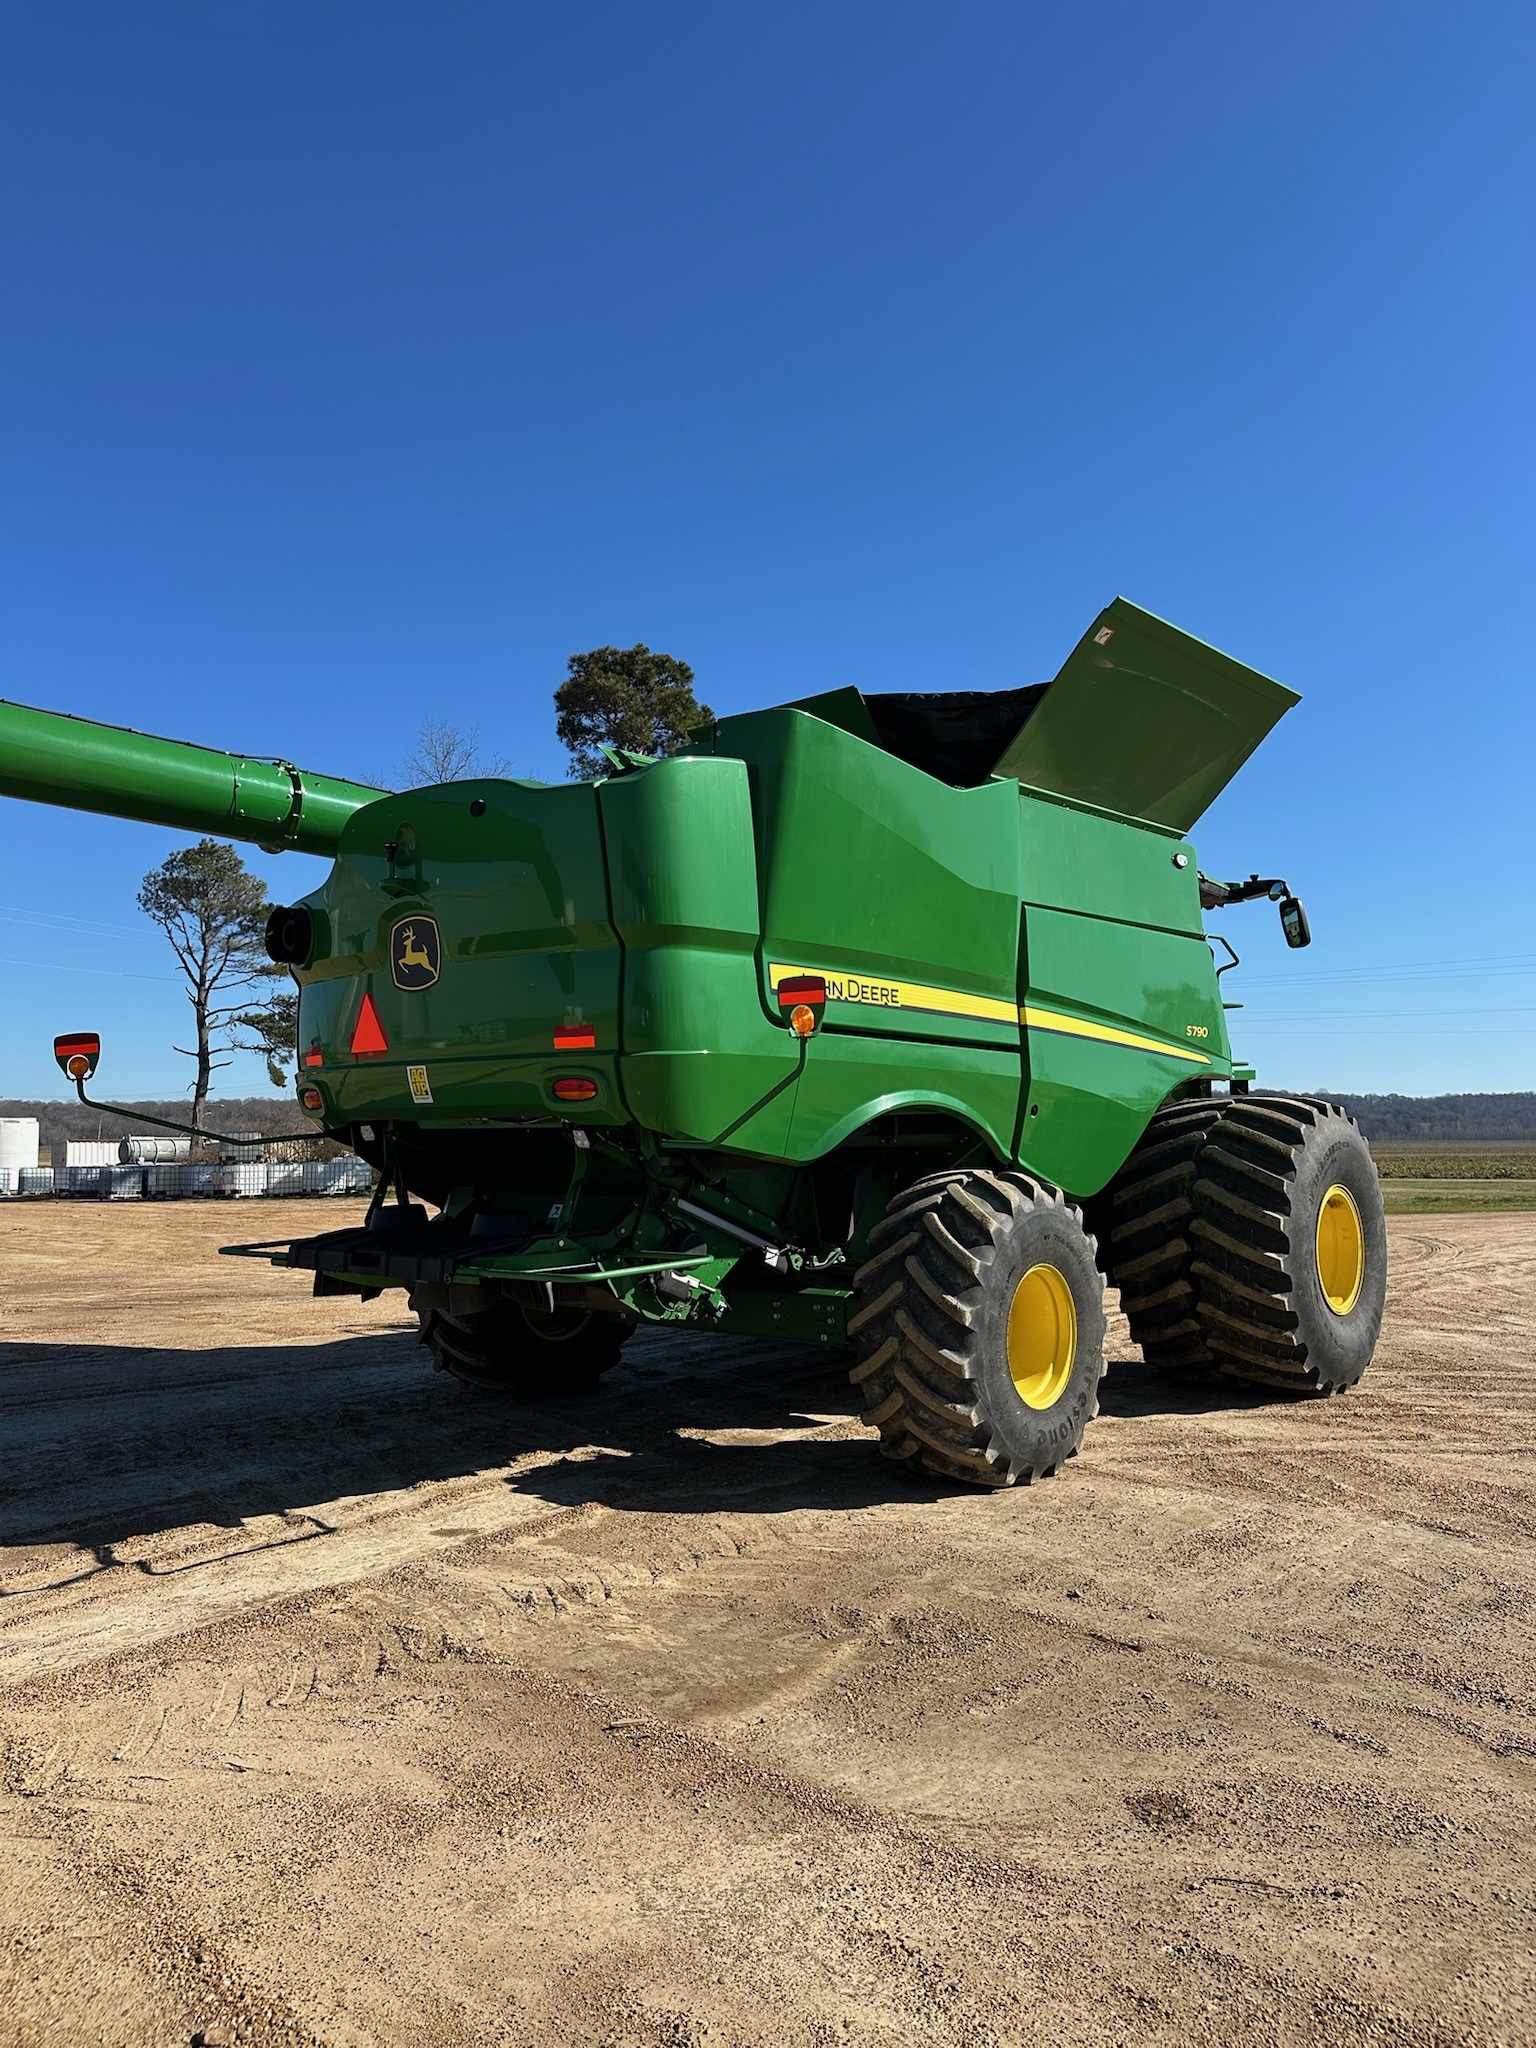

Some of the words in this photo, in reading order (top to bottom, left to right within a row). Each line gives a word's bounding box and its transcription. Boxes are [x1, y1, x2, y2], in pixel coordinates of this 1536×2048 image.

[825, 980, 843, 997] HN
[848, 980, 899, 1003] DEERE
[1186, 1025, 1208, 1038] S790
[411, 1069, 425, 1082] AG
[412, 1082, 427, 1096] UP
